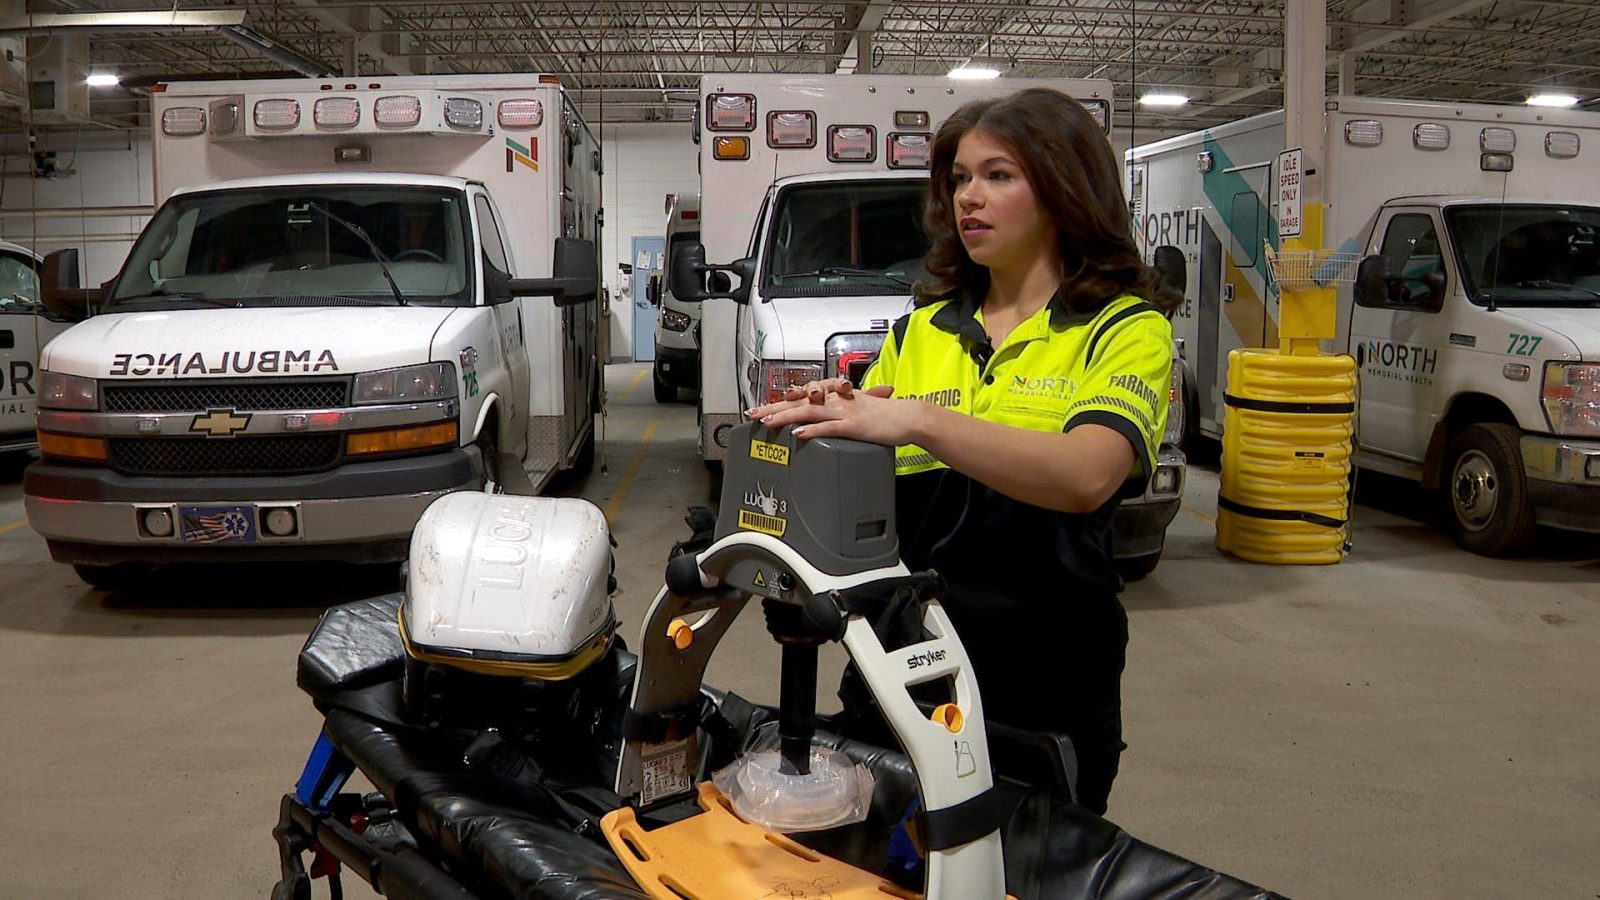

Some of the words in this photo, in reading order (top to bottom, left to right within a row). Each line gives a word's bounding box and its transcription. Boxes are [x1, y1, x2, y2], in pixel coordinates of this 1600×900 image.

[1283, 158, 1297, 171] IDLE
[1280, 172, 1299, 187] SPEED
[1282, 189, 1297, 201] ONLY
[1286, 206, 1292, 215] IN
[1280, 216, 1298, 228] GARAGE
[1507, 333, 1542, 356] 727
[1368, 340, 1437, 374] NORTH
[462, 370, 479, 401] 725
[1368, 368, 1402, 381] MEMORIAL
[1405, 375, 1433, 388] HEALTH
[744, 491, 778, 511] LUCS
[780, 501, 787, 513] 3
[907, 650, 946, 670] stryker
